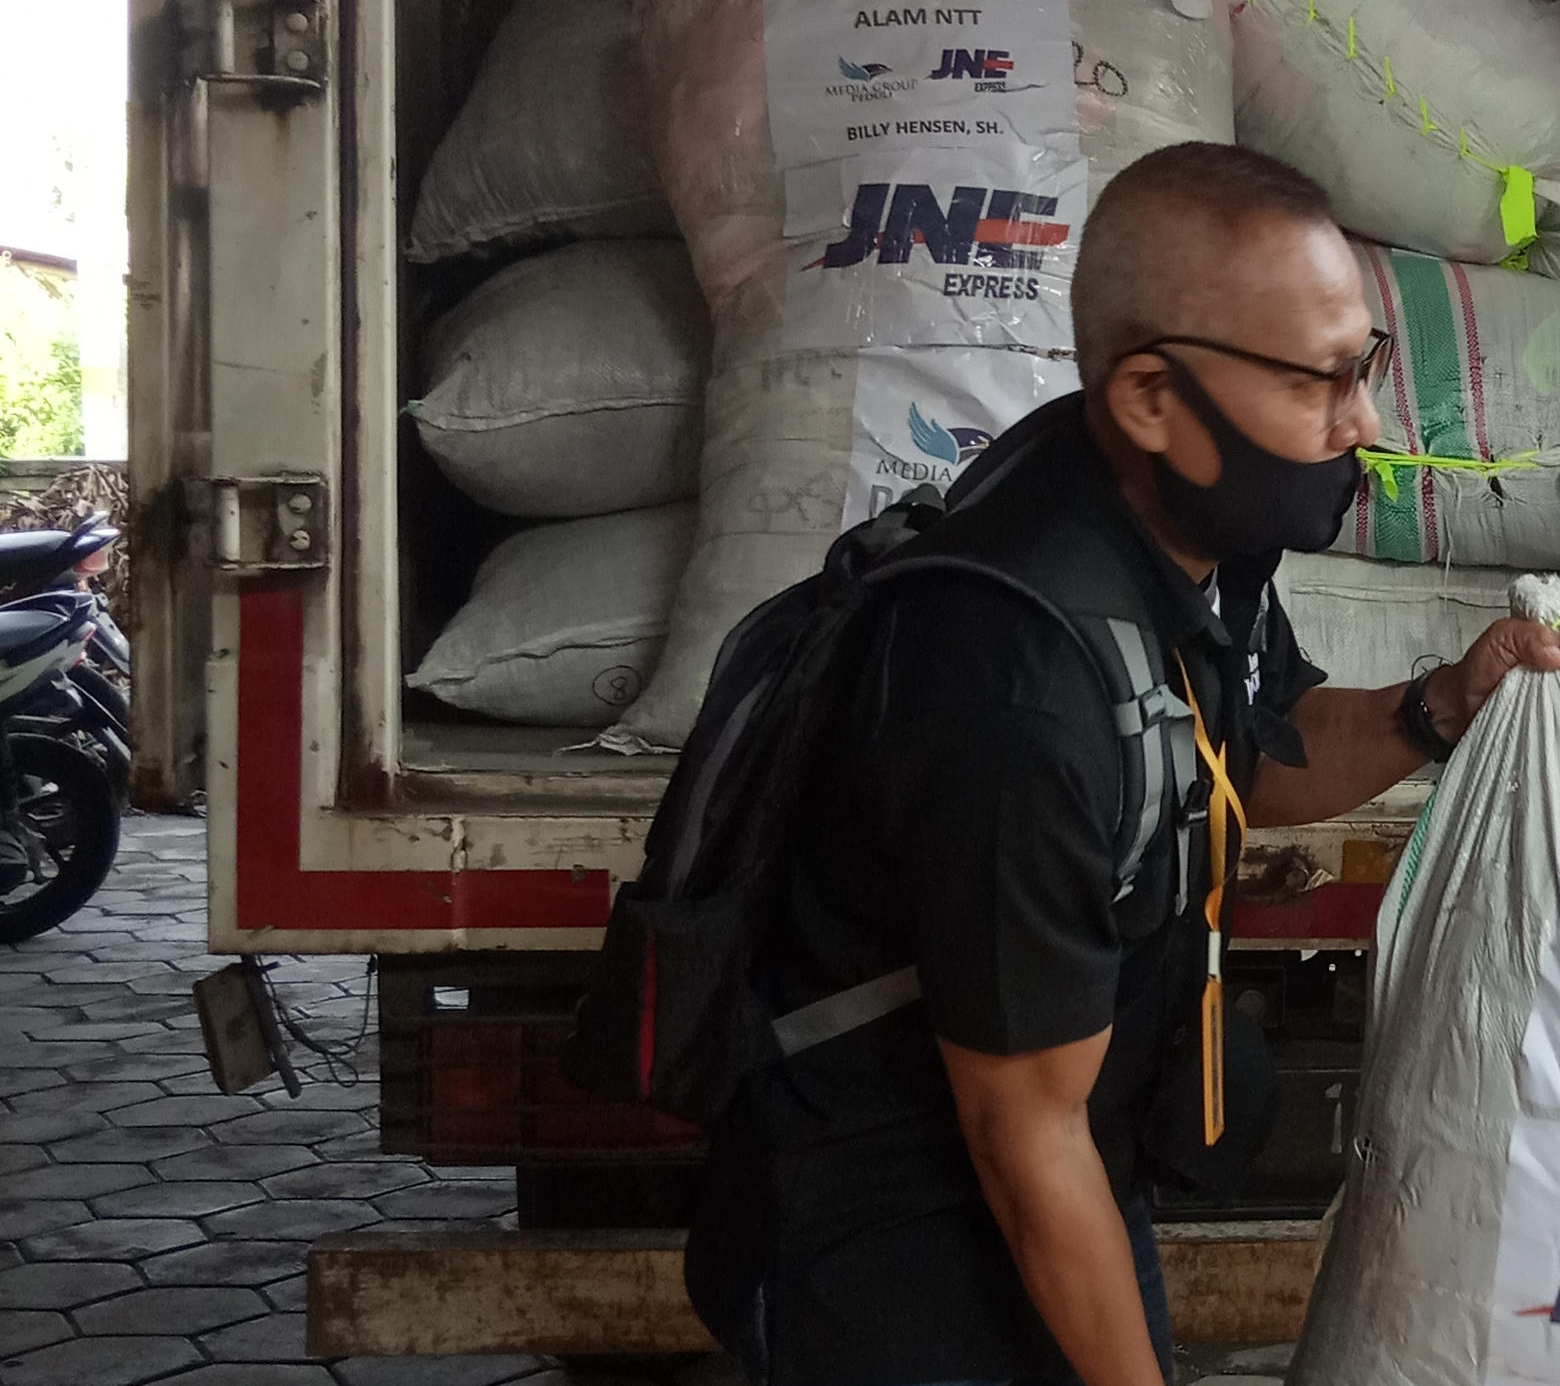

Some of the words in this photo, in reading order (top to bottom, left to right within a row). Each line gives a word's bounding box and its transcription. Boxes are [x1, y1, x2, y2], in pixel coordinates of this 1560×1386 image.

[853, 8, 928, 29] ALAM
[935, 9, 983, 26] NTT
[926, 48, 1015, 81] JNE
[825, 83, 870, 98] MEDIA
[872, 78, 919, 93] GROUP
[851, 91, 893, 103] PEDULI
[847, 121, 892, 142] BILLY
[896, 119, 972, 136] HENSEN,
[975, 120, 1005, 135] SH.
[802, 182, 1071, 271] JNE
[942, 272, 1041, 301] EXPRESS
[875, 459, 953, 483] MEDIA
